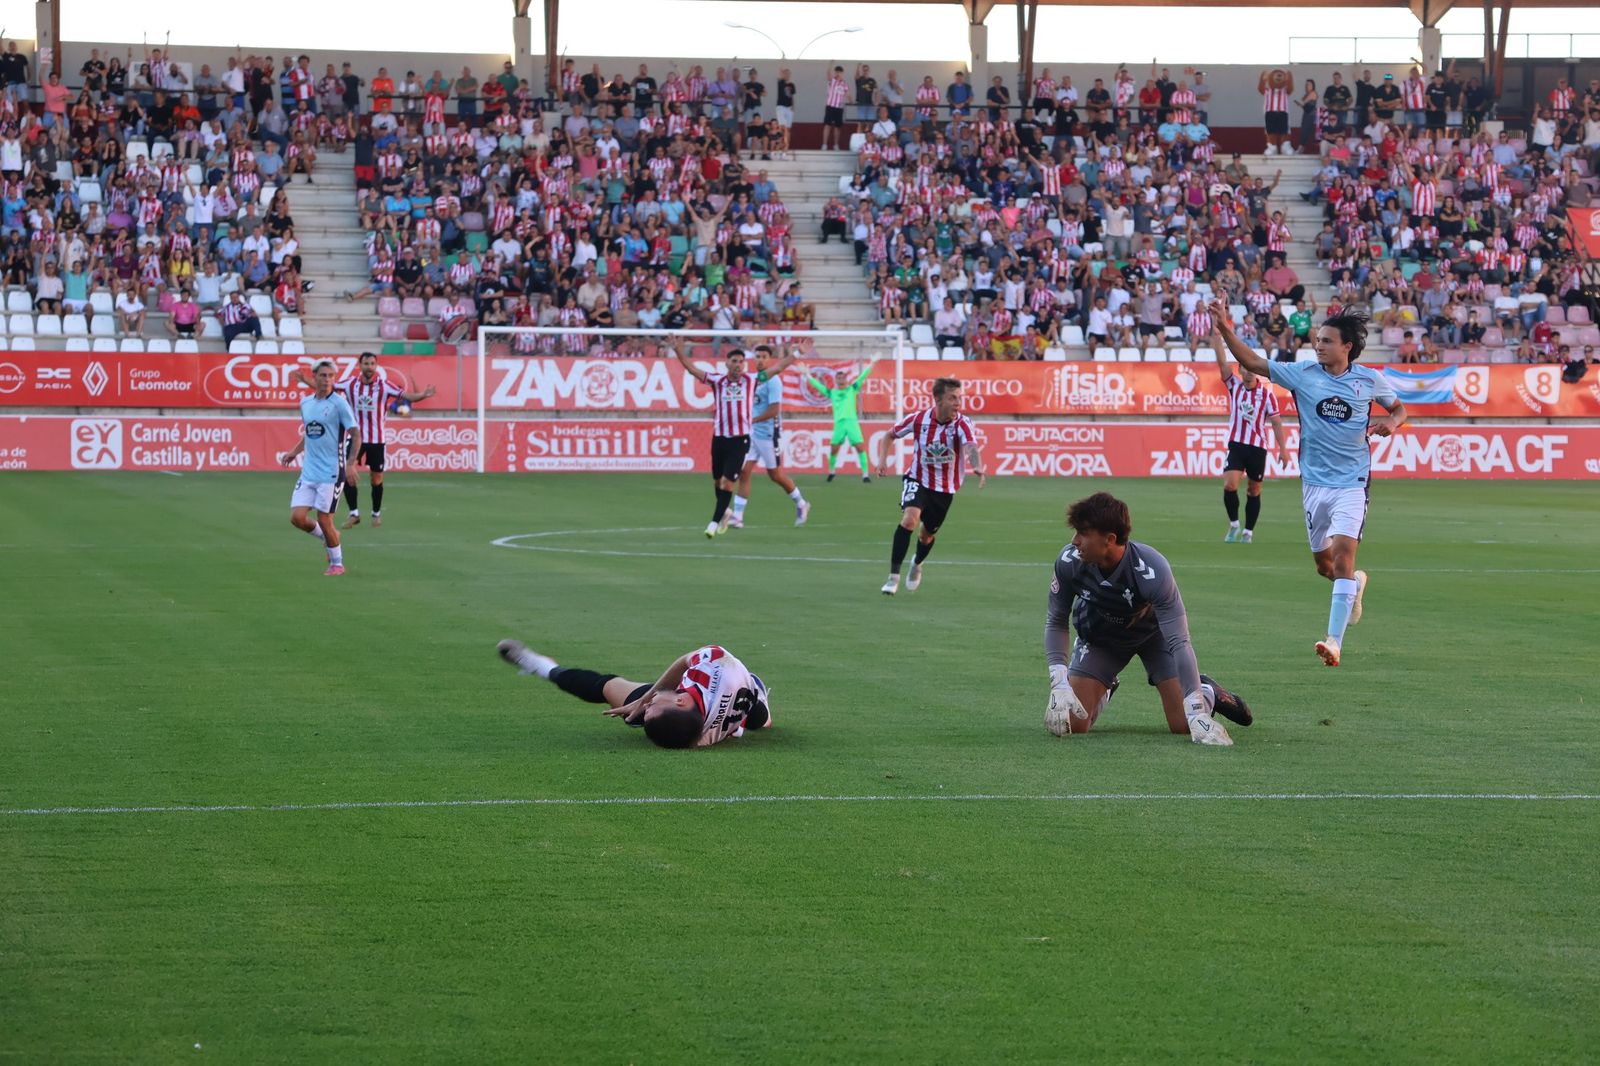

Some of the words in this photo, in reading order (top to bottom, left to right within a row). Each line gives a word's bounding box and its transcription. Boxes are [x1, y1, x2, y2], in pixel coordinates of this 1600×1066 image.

[130, 369, 160, 379] Grupo
[1061, 365, 1125, 392] fisio
[1466, 372, 1480, 396] 8
[1537, 372, 1551, 396] 8
[130, 380, 192, 391] Leomotor
[1061, 387, 1135, 409] readapt
[1144, 391, 1227, 410] podoactiva
[1322, 402, 1347, 412] Estrella
[1322, 408, 1345, 418] Galicia
[131, 423, 178, 443] Carné
[186, 424, 231, 443] Joven
[553, 425, 610, 437] bodegas
[652, 425, 673, 436] del
[527, 430, 688, 456] Sumiller
[1517, 434, 1568, 472] CF
[132, 446, 192, 466] Castilla
[196, 454, 208, 470] y
[209, 446, 249, 466] León
[996, 453, 1112, 475] ZAMORA
